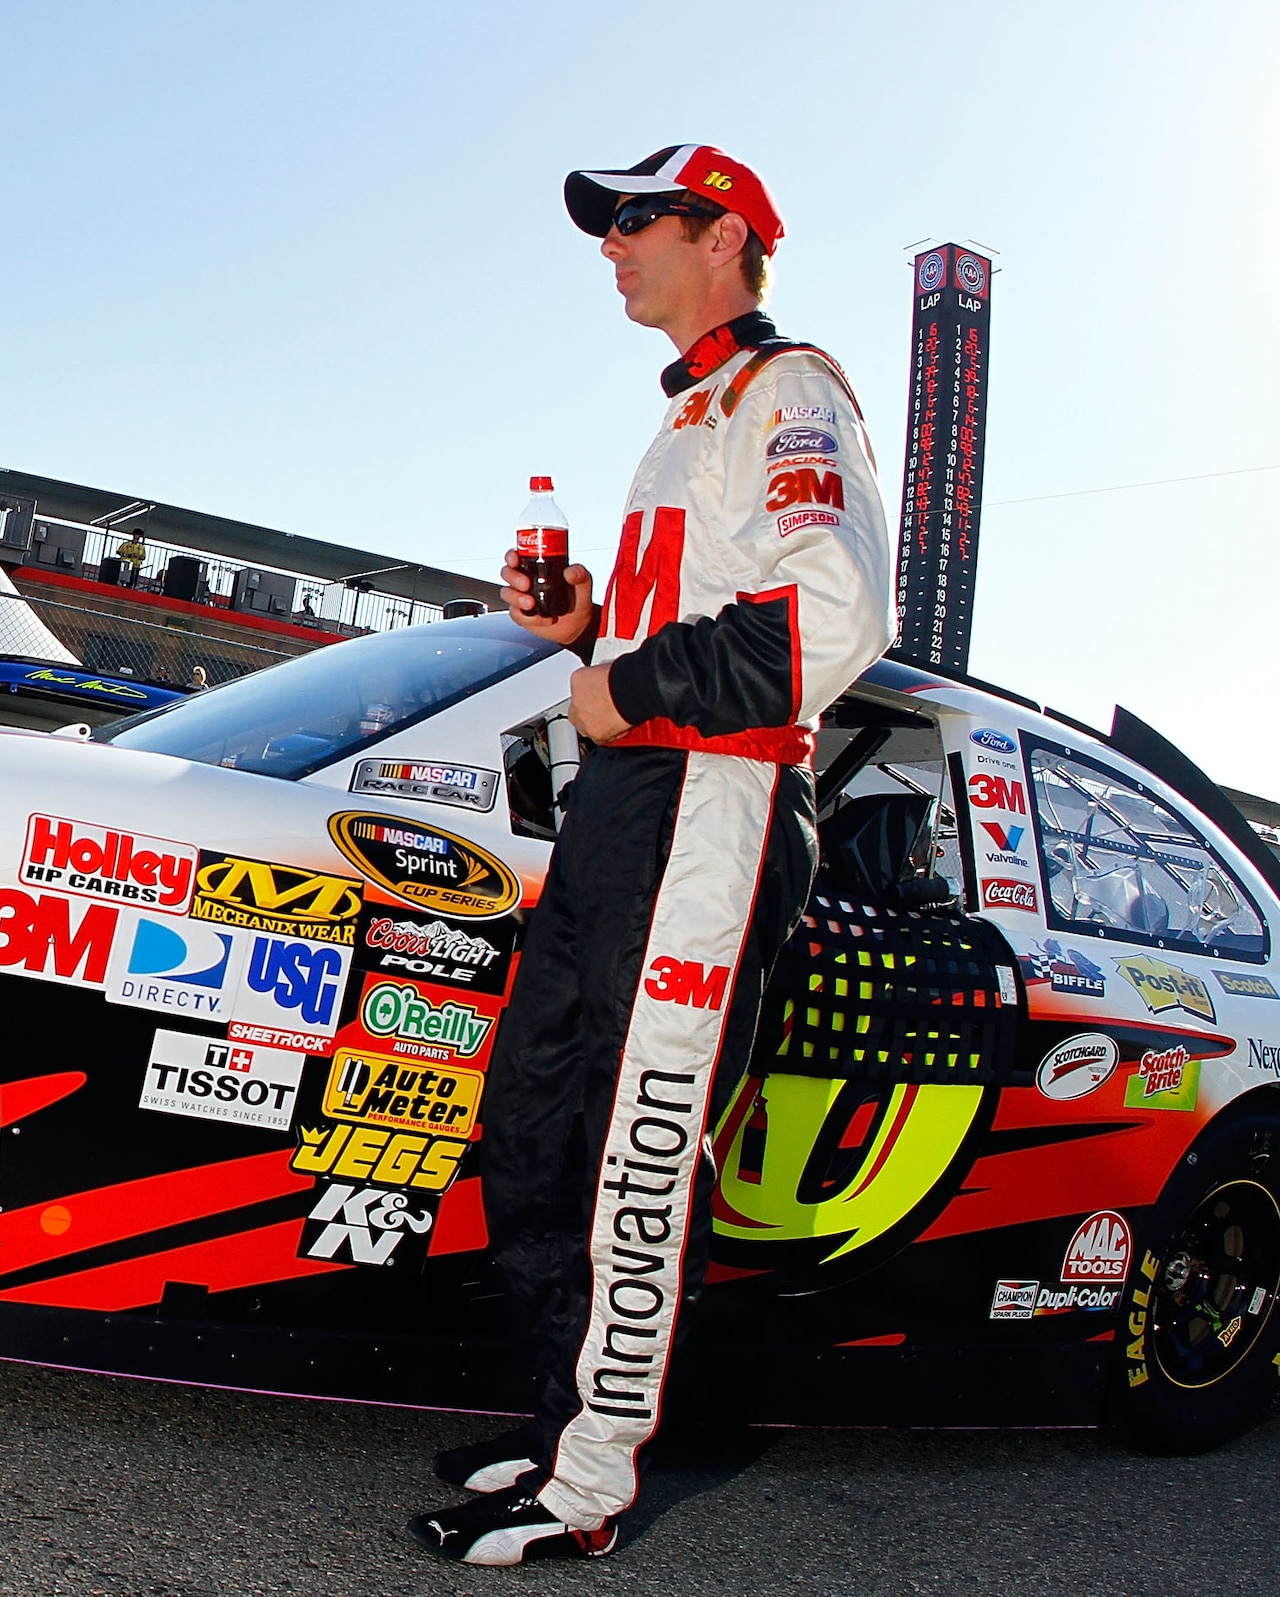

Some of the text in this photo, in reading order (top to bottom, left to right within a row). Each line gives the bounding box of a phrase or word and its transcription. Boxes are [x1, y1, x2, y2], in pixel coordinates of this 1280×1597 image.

[703, 171, 734, 191] 16
[921, 293, 940, 310] LAP
[958, 293, 982, 312] LAP
[919, 328, 923, 339] 1
[956, 324, 961, 335] 1
[684, 325, 740, 378] 3M
[918, 342, 923, 354] 2
[956, 338, 961, 350] 2
[917, 356, 922, 368] 3
[955, 352, 961, 364] 3
[916, 370, 922, 381] 4
[954, 367, 960, 378] 4
[916, 384, 921, 396] 5
[954, 381, 960, 392] 5
[915, 399, 920, 410] 6
[953, 395, 959, 407] 6
[781, 407, 834, 423] NASCAR
[914, 413, 920, 424] 7
[953, 409, 958, 421] 7
[913, 427, 919, 439] 8
[952, 424, 957, 436] 8
[776, 431, 823, 453] Ford
[913, 442, 918, 454] 9
[951, 439, 957, 451] 9
[767, 456, 837, 473] RACING
[909, 457, 917, 469] 10
[947, 453, 956, 466] 10
[908, 471, 914, 483] 11
[946, 468, 953, 481] 11
[766, 468, 845, 512] 3M
[907, 486, 914, 498] 12
[945, 483, 953, 496] 12
[906, 500, 913, 513] 13
[944, 498, 953, 511] 13
[782, 512, 836, 532] SIMPSON
[904, 516, 912, 528] 14
[943, 513, 951, 526] 14
[903, 530, 911, 542] 15
[942, 528, 950, 541] 15
[902, 545, 910, 557] 16
[940, 543, 949, 556] 16
[901, 560, 908, 572] 17
[939, 558, 948, 571] 17
[899, 575, 907, 587] 18
[937, 574, 947, 587] 18
[898, 590, 906, 602] 19
[936, 589, 946, 602] 19
[934, 604, 946, 618] 20
[933, 620, 943, 633] 21
[931, 635, 942, 649] 22
[930, 650, 941, 664] 23
[980, 731, 1010, 750] Ford
[977, 755, 1019, 771] Drive one.
[410, 765, 475, 788] NASCAR
[362, 780, 483, 803] RACE CAR
[968, 773, 1027, 815] 3M
[382, 827, 446, 853] NASCAR
[29, 817, 193, 906] Holley
[395, 848, 458, 878] Sprint
[986, 852, 1029, 867] Valvoline
[26, 864, 159, 903] HP CARBS
[402, 884, 497, 911] CUP SERIES
[984, 880, 1035, 908] Coca-Cola
[191, 895, 356, 946] MECHANIX WEAR
[366, 918, 501, 967] Coors LIGHT
[379, 954, 476, 982] POLE
[247, 936, 342, 1027] USG
[644, 955, 731, 1011] 3M
[1053, 974, 1104, 991] BIFFLE
[1126, 966, 1205, 999] Post-it
[1220, 975, 1275, 995] Scotch
[122, 980, 222, 1013] DIRECTV
[369, 990, 484, 1051] O'Reilly
[230, 1023, 326, 1052] SHEETROCK
[393, 1041, 450, 1061] AUTO PARTS
[1053, 1046, 1107, 1067] SCOTCHGARD
[151, 1062, 295, 1110] TISSOT
[374, 1063, 457, 1099] Auto
[1145, 1069, 1181, 1095] Brite
[143, 1095, 289, 1126] SWISS WATCHES SINCE 1853
[367, 1087, 469, 1125] Meter
[368, 1112, 461, 1134] PERFORMANCE GAUGES
[293, 1124, 467, 1191] JEGS
[590, 1069, 696, 1420] Innovation
[1069, 1217, 1127, 1260] MAC
[1068, 1261, 1124, 1275] TOOLS
[997, 1290, 1034, 1302] CHAMPION
[1127, 1249, 1160, 1388] EAGLE
[1222, 1320, 1240, 1342] AERO
